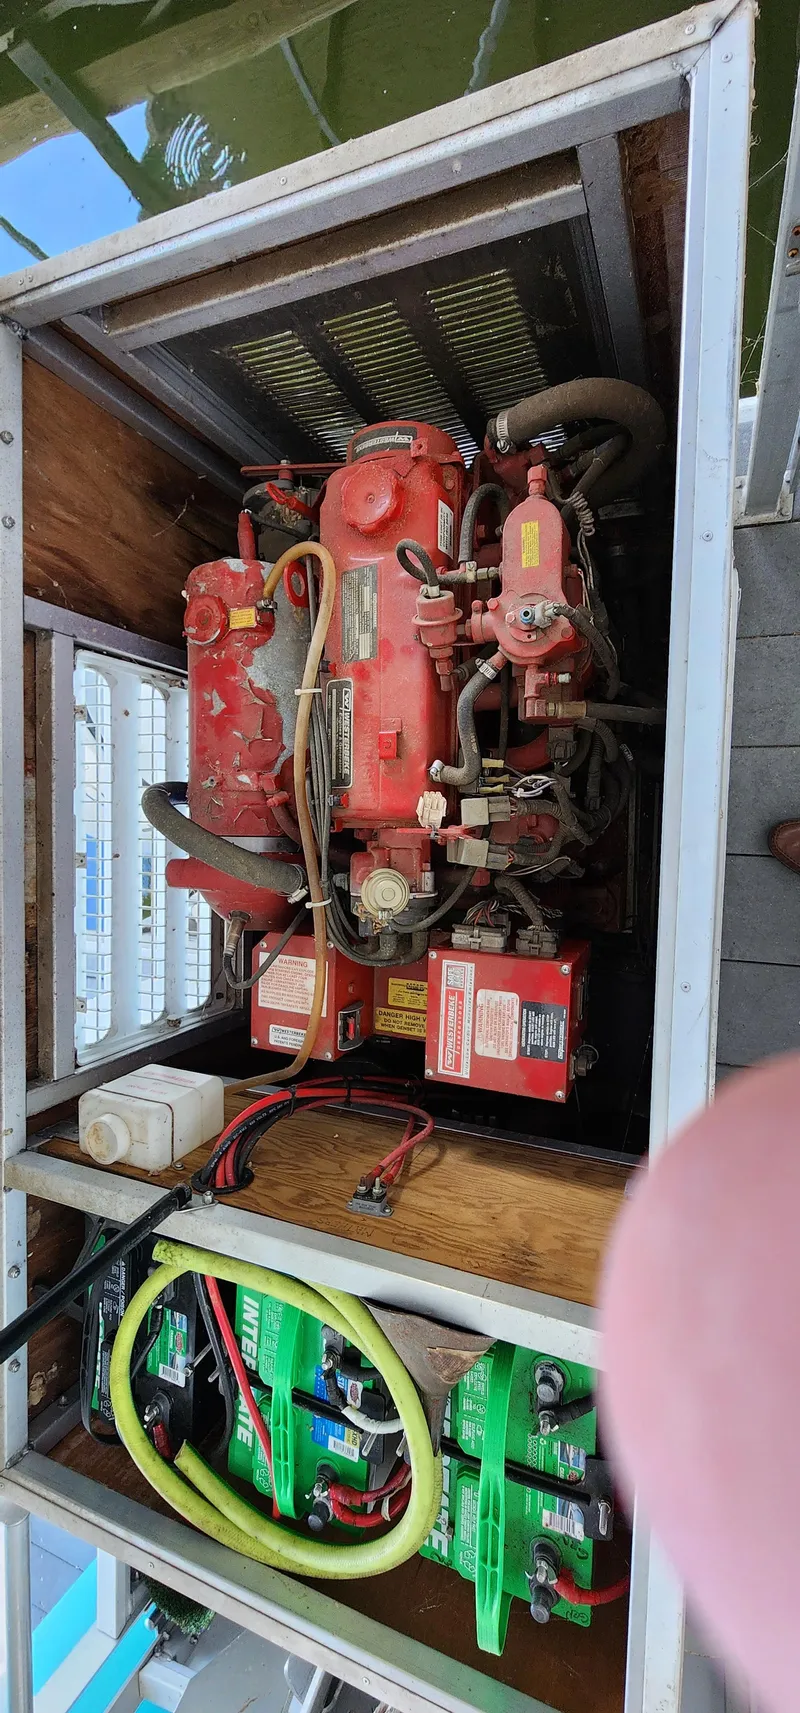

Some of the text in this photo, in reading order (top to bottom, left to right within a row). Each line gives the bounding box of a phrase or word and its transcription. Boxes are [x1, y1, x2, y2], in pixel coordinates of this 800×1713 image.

[278, 958, 308, 967] WARNING
[378, 1010, 404, 1019] DANGER
[404, 1021, 425, 1029] REMOVE
